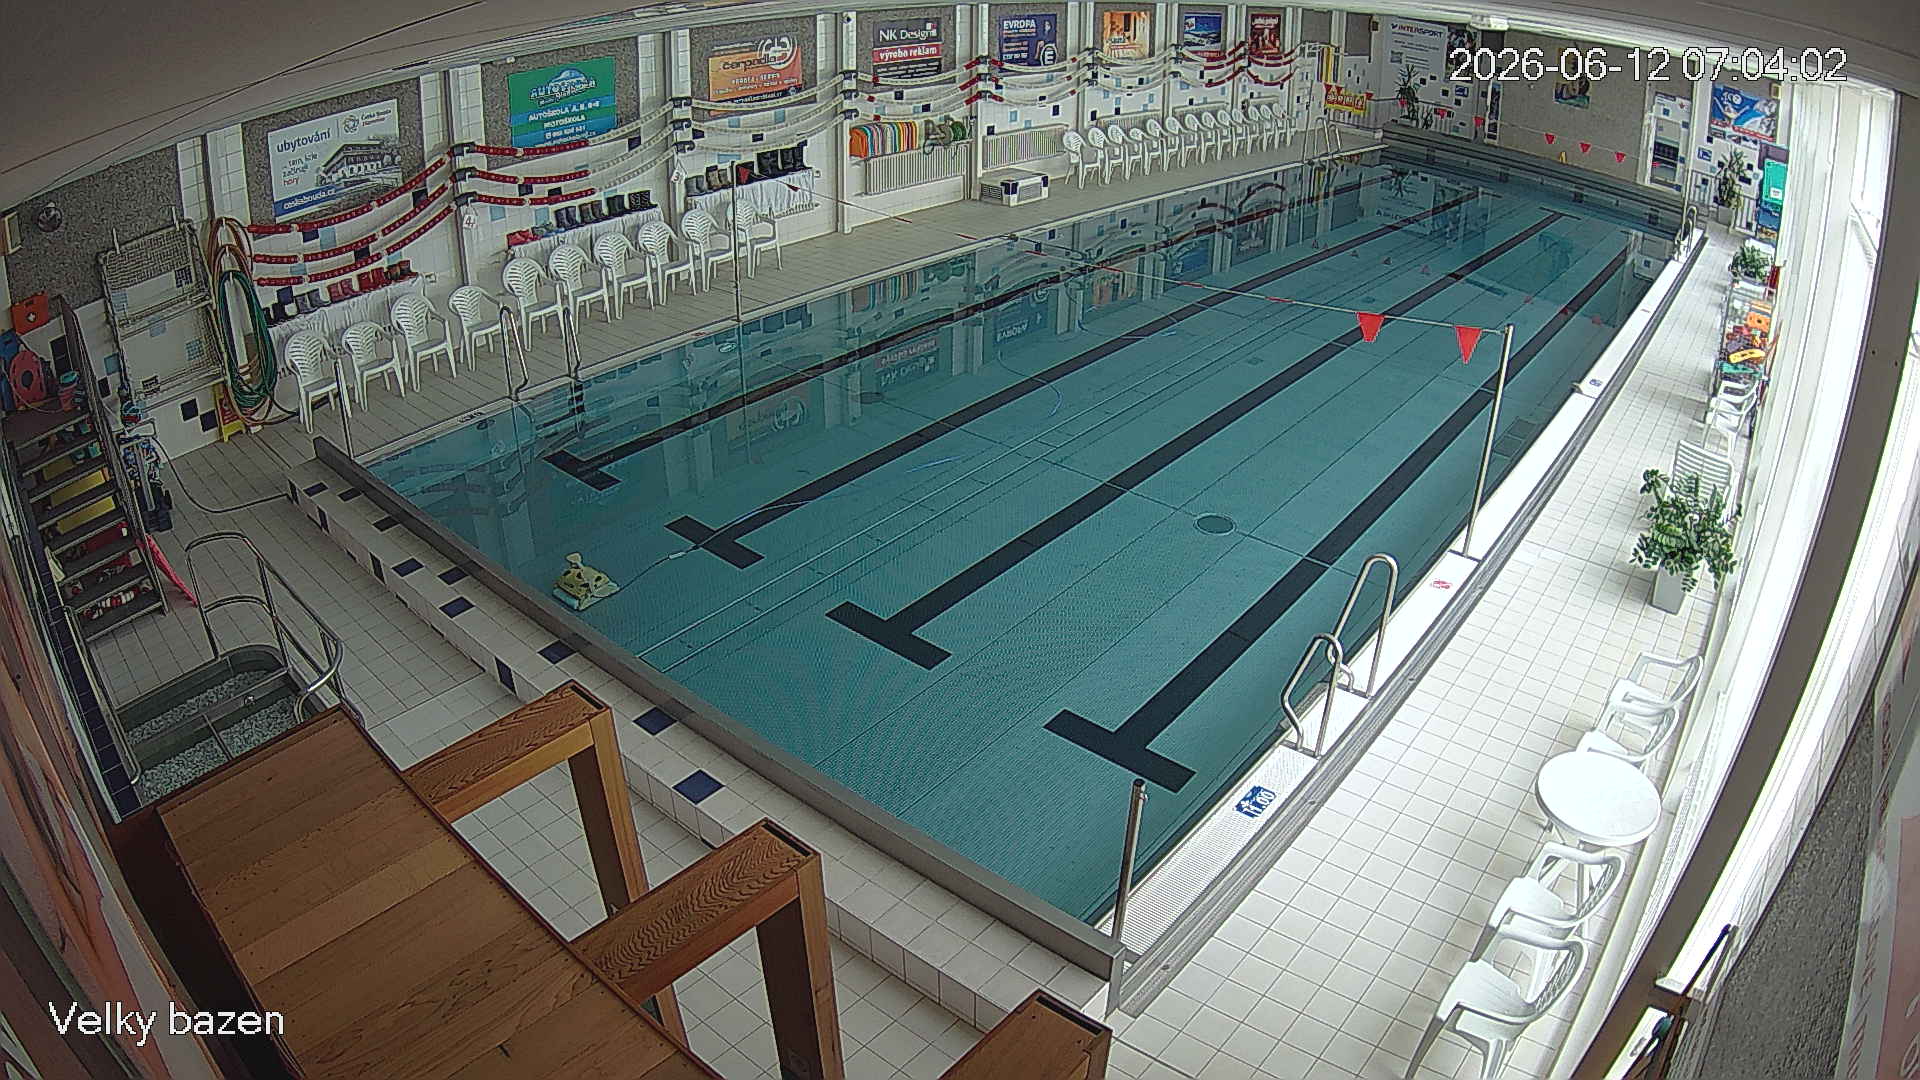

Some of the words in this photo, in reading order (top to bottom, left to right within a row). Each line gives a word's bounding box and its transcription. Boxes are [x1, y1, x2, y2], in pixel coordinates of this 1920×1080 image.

[1003, 19, 1036, 30] EVROPA
[879, 29, 898, 41] NK
[900, 29, 934, 40] Design
[1398, 25, 1443, 38] INTERSPORT
[909, 46, 937, 57] reklam
[276, 127, 332, 153] ubytování
